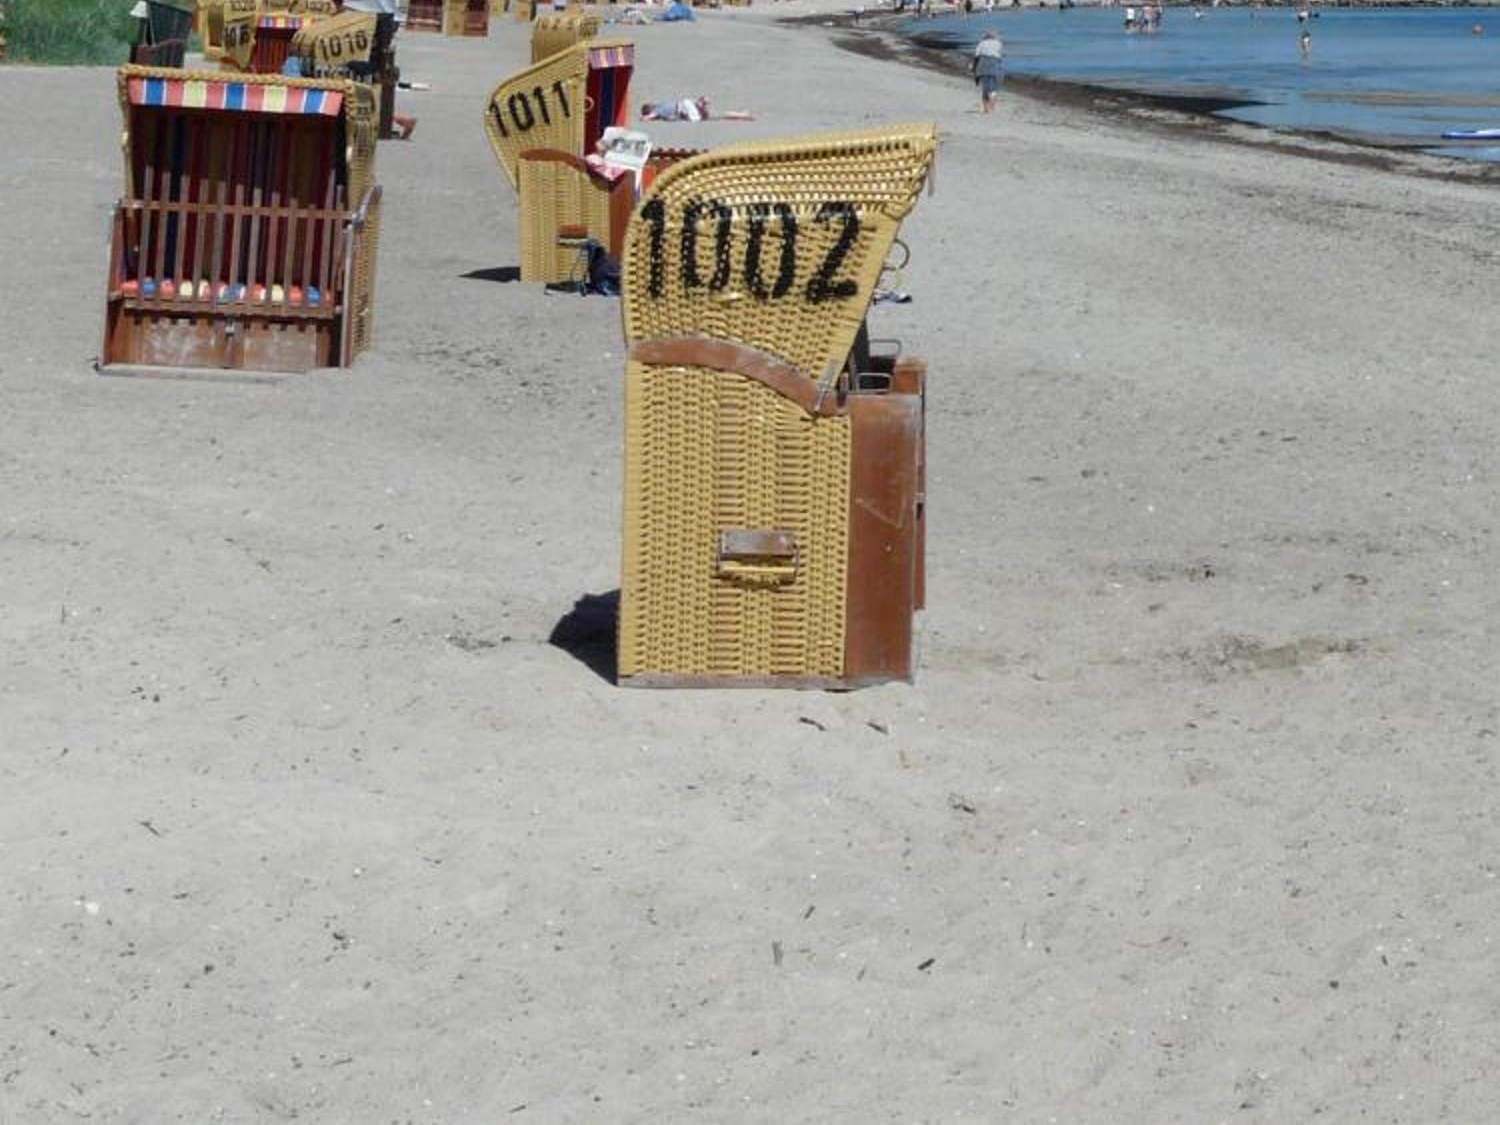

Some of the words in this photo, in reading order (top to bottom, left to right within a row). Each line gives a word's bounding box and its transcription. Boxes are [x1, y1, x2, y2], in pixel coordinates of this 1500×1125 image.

[318, 29, 368, 61] 1010
[489, 80, 570, 137] 1011
[640, 194, 860, 303] 1002
